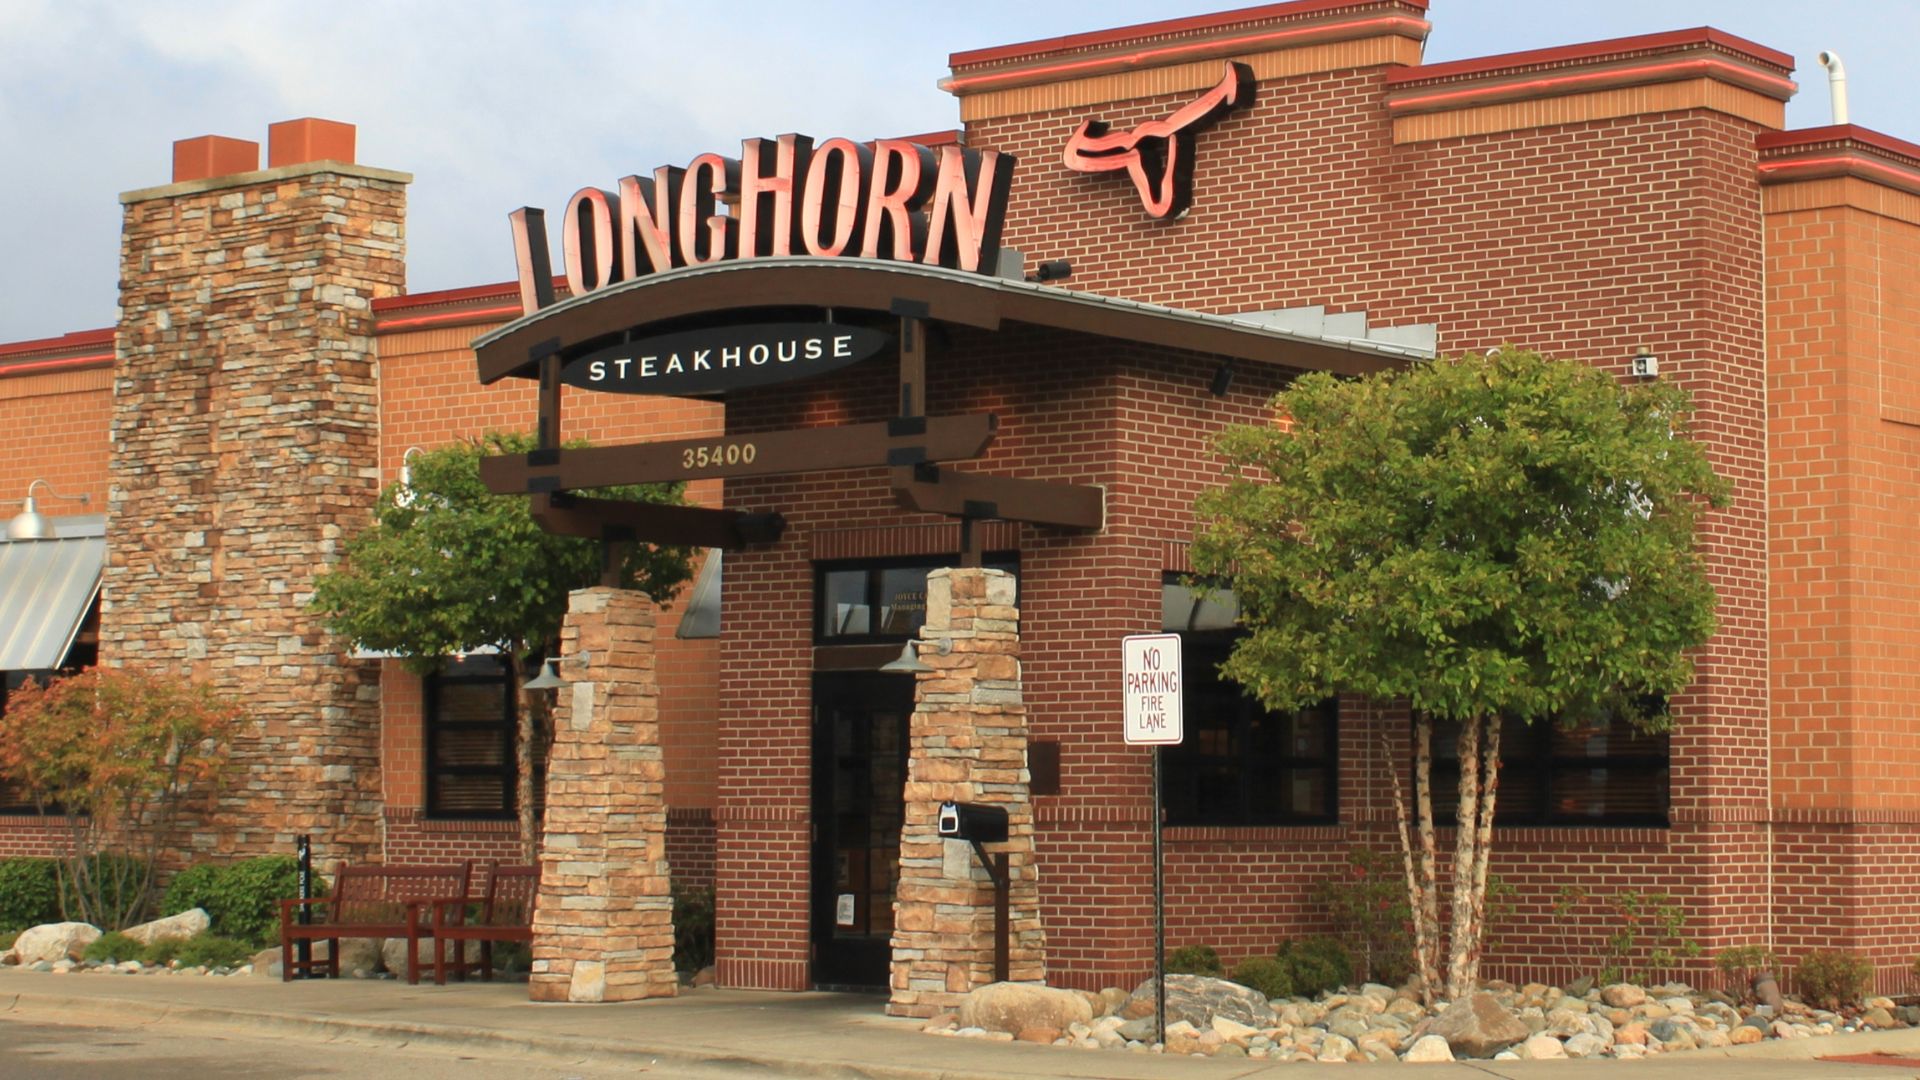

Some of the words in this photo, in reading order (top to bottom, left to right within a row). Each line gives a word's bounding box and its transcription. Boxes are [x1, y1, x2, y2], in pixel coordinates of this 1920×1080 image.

[508, 133, 1017, 315] LONGHORN
[589, 335, 852, 381] STEAKHOUSE
[682, 443, 757, 470] 35400
[1143, 648, 1161, 671] NO
[1127, 671, 1178, 694] PARKING
[1141, 695, 1164, 712] FIRE
[1139, 713, 1166, 729] LANE
